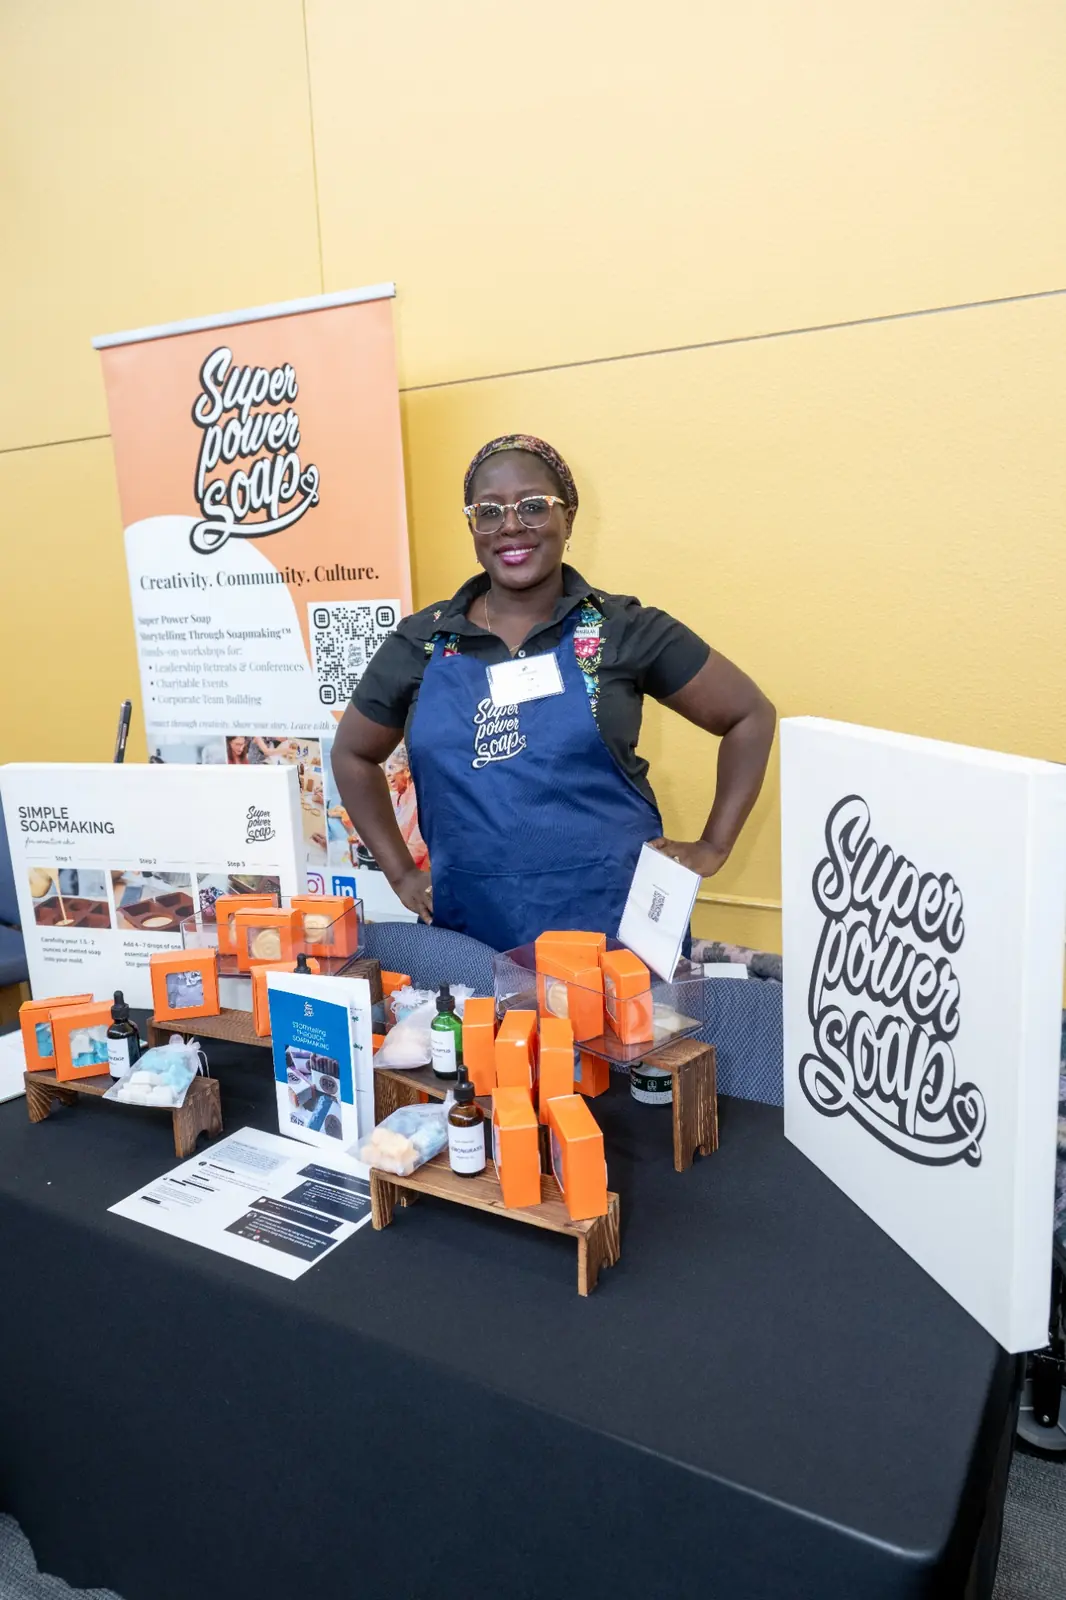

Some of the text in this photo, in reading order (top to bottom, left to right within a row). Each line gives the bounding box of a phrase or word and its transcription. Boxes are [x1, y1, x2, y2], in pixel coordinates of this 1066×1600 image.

[192, 346, 298, 428] Super
[195, 408, 301, 502] power
[190, 450, 319, 554] soap
[140, 563, 379, 591] Creativity. Community. Culture.
[138, 614, 211, 626] Super Power Soap
[140, 630, 186, 642] Storytelling
[189, 629, 224, 640] Through
[181, 646, 225, 658] workshops
[155, 662, 304, 674] Leadership Retreats & Conferences
[156, 679, 228, 690] Charitable Events
[157, 695, 262, 706] Corporate Team Building
[474, 698, 519, 723] Super
[475, 717, 519, 750] power
[472, 732, 527, 769] soap
[18, 806, 69, 819] SIMPLE
[246, 805, 271, 819] Super
[20, 819, 115, 834] SOAPMAKING
[247, 819, 271, 834] power
[245, 827, 276, 844] soap
[227, 860, 240, 868] Step
[812, 794, 964, 953] Super
[808, 916, 960, 1043] power
[799, 1004, 987, 1168] soap
